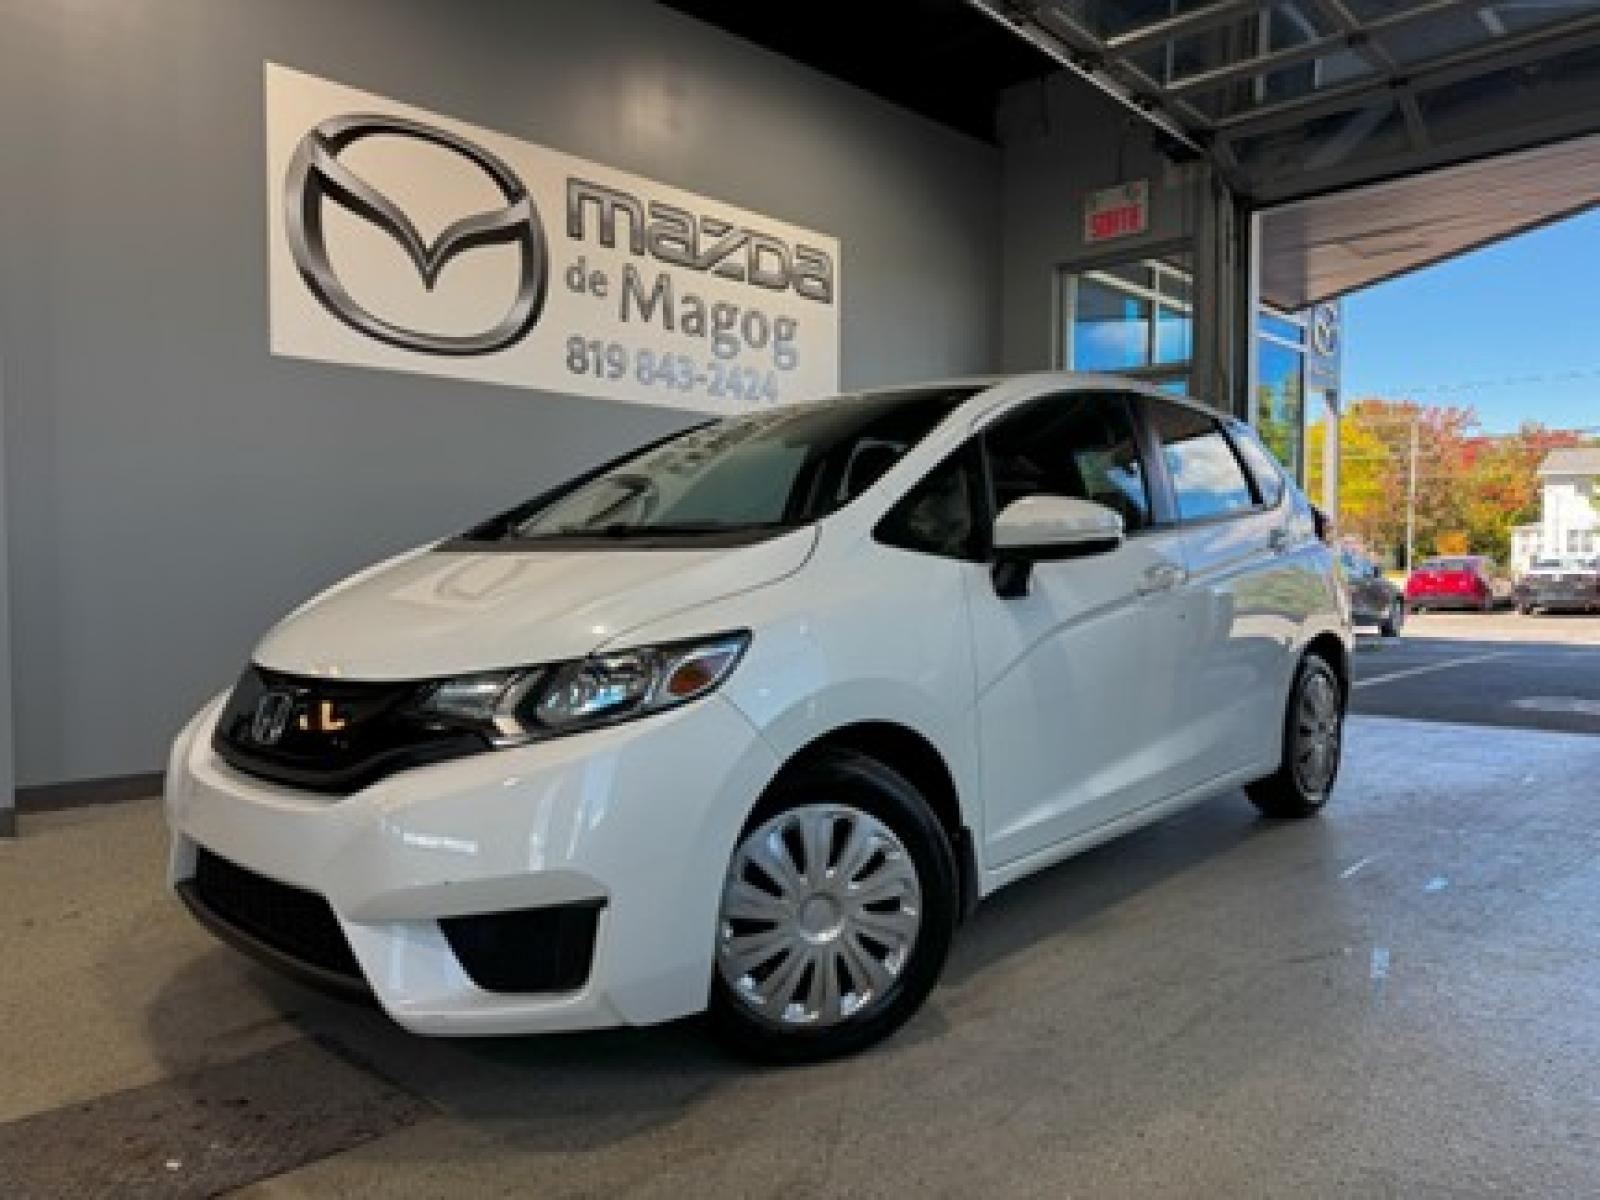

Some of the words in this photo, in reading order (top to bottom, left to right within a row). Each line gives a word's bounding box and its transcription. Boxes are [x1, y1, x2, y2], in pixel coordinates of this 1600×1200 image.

[566, 177, 833, 304] mazda
[566, 256, 608, 296] de
[619, 262, 797, 370] Magog
[566, 336, 626, 379] 819
[636, 349, 778, 401] 843-2424
